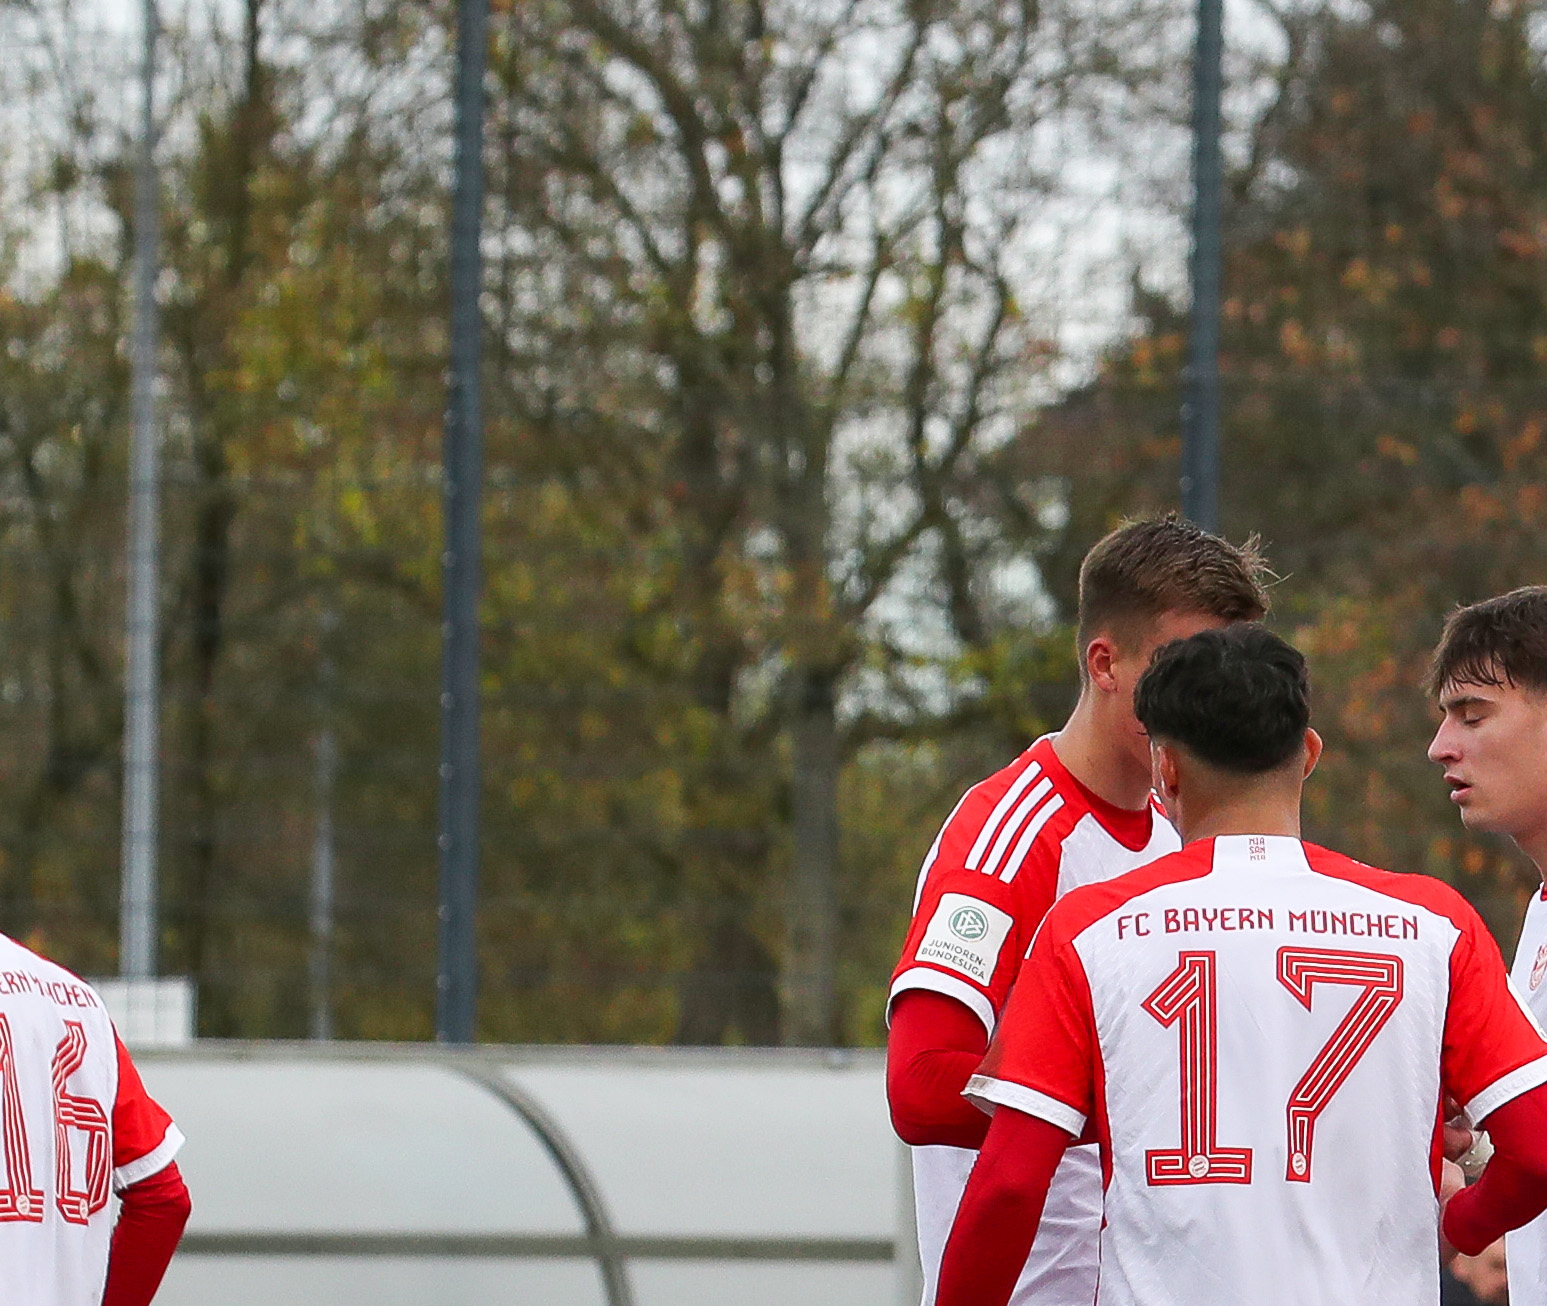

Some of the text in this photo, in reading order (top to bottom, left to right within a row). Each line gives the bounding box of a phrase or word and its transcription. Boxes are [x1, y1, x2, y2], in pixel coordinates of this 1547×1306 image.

[1118, 908, 1418, 940] FC BAYERN MÜNCHEN
[921, 947, 985, 980] BUNDESLIGA
[928, 939, 987, 967] JUNIOREN-
[1140, 945, 1404, 1187] 17
